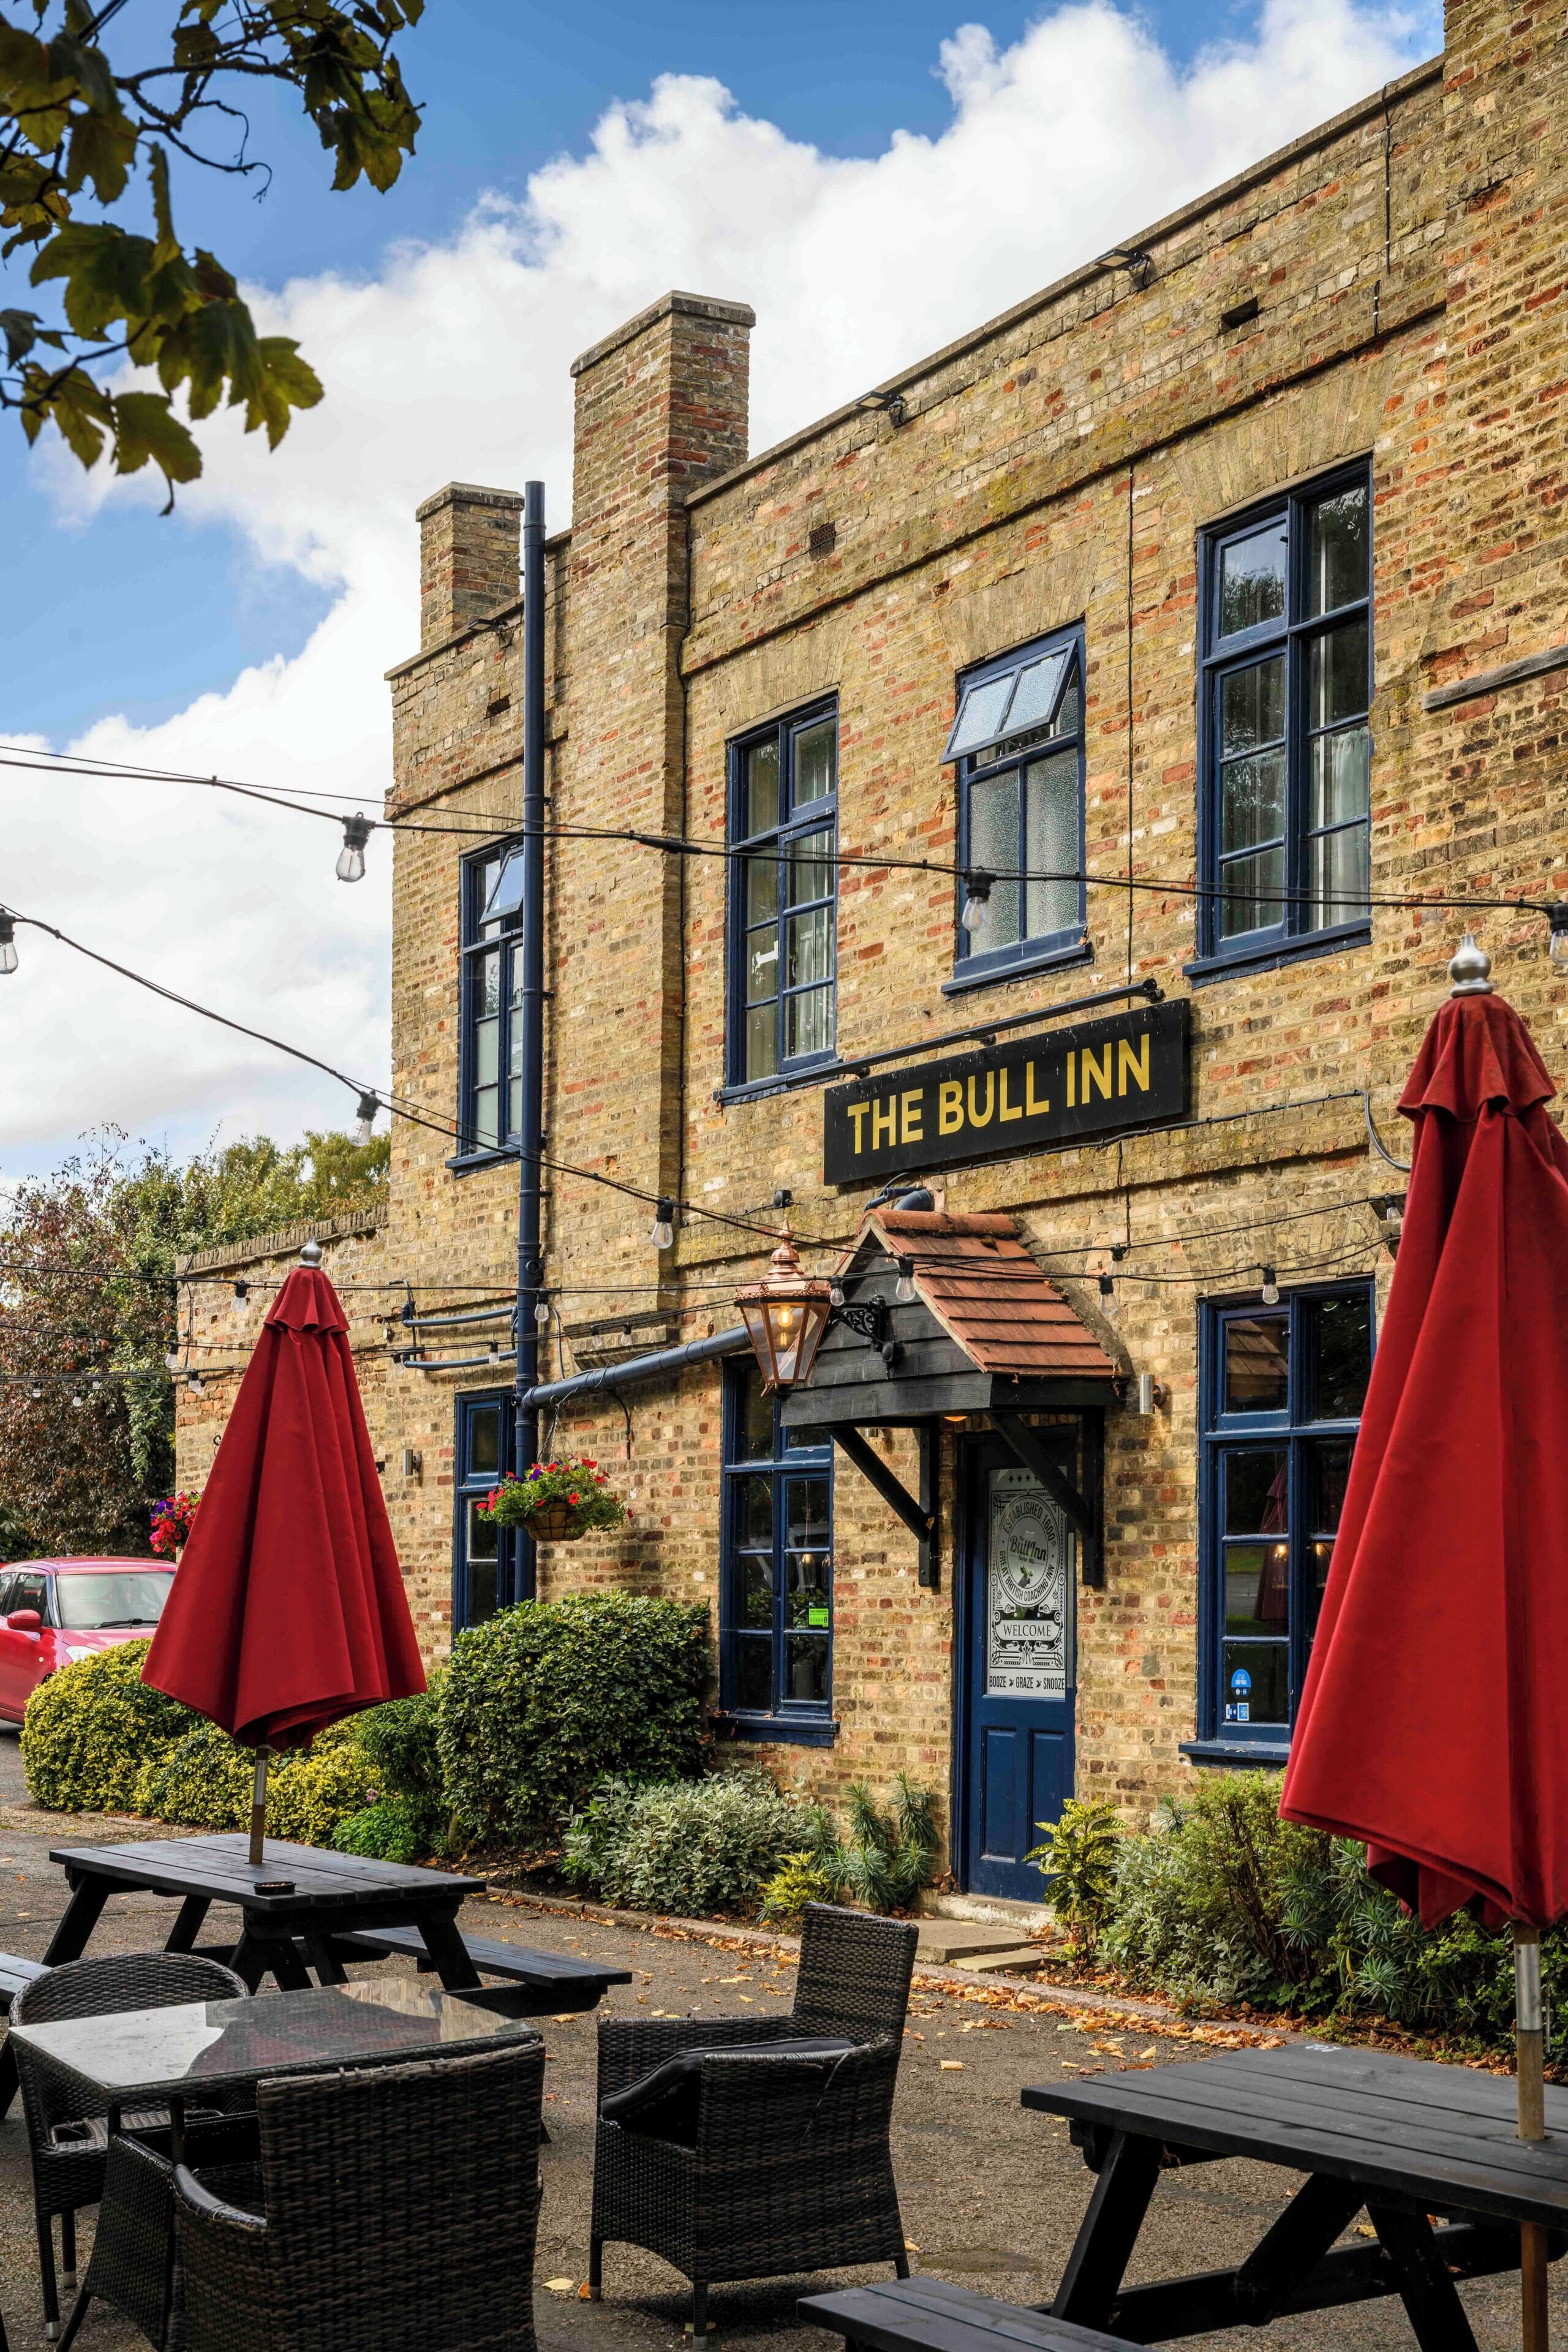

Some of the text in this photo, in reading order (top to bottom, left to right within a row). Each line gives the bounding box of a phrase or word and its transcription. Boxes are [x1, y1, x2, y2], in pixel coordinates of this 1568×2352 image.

[848, 1034, 1150, 1154] THE BULL INN
[1003, 1502, 1043, 1534] ESTABLISHED
[1010, 1536, 1046, 1561] Bull Inn
[1000, 1550, 1055, 1602] GREAT BRITISH COACHING INN
[1003, 1624, 1051, 1637] WELCOME
[989, 1676, 1065, 1690] BOOZE GRAZE SNOOZE
